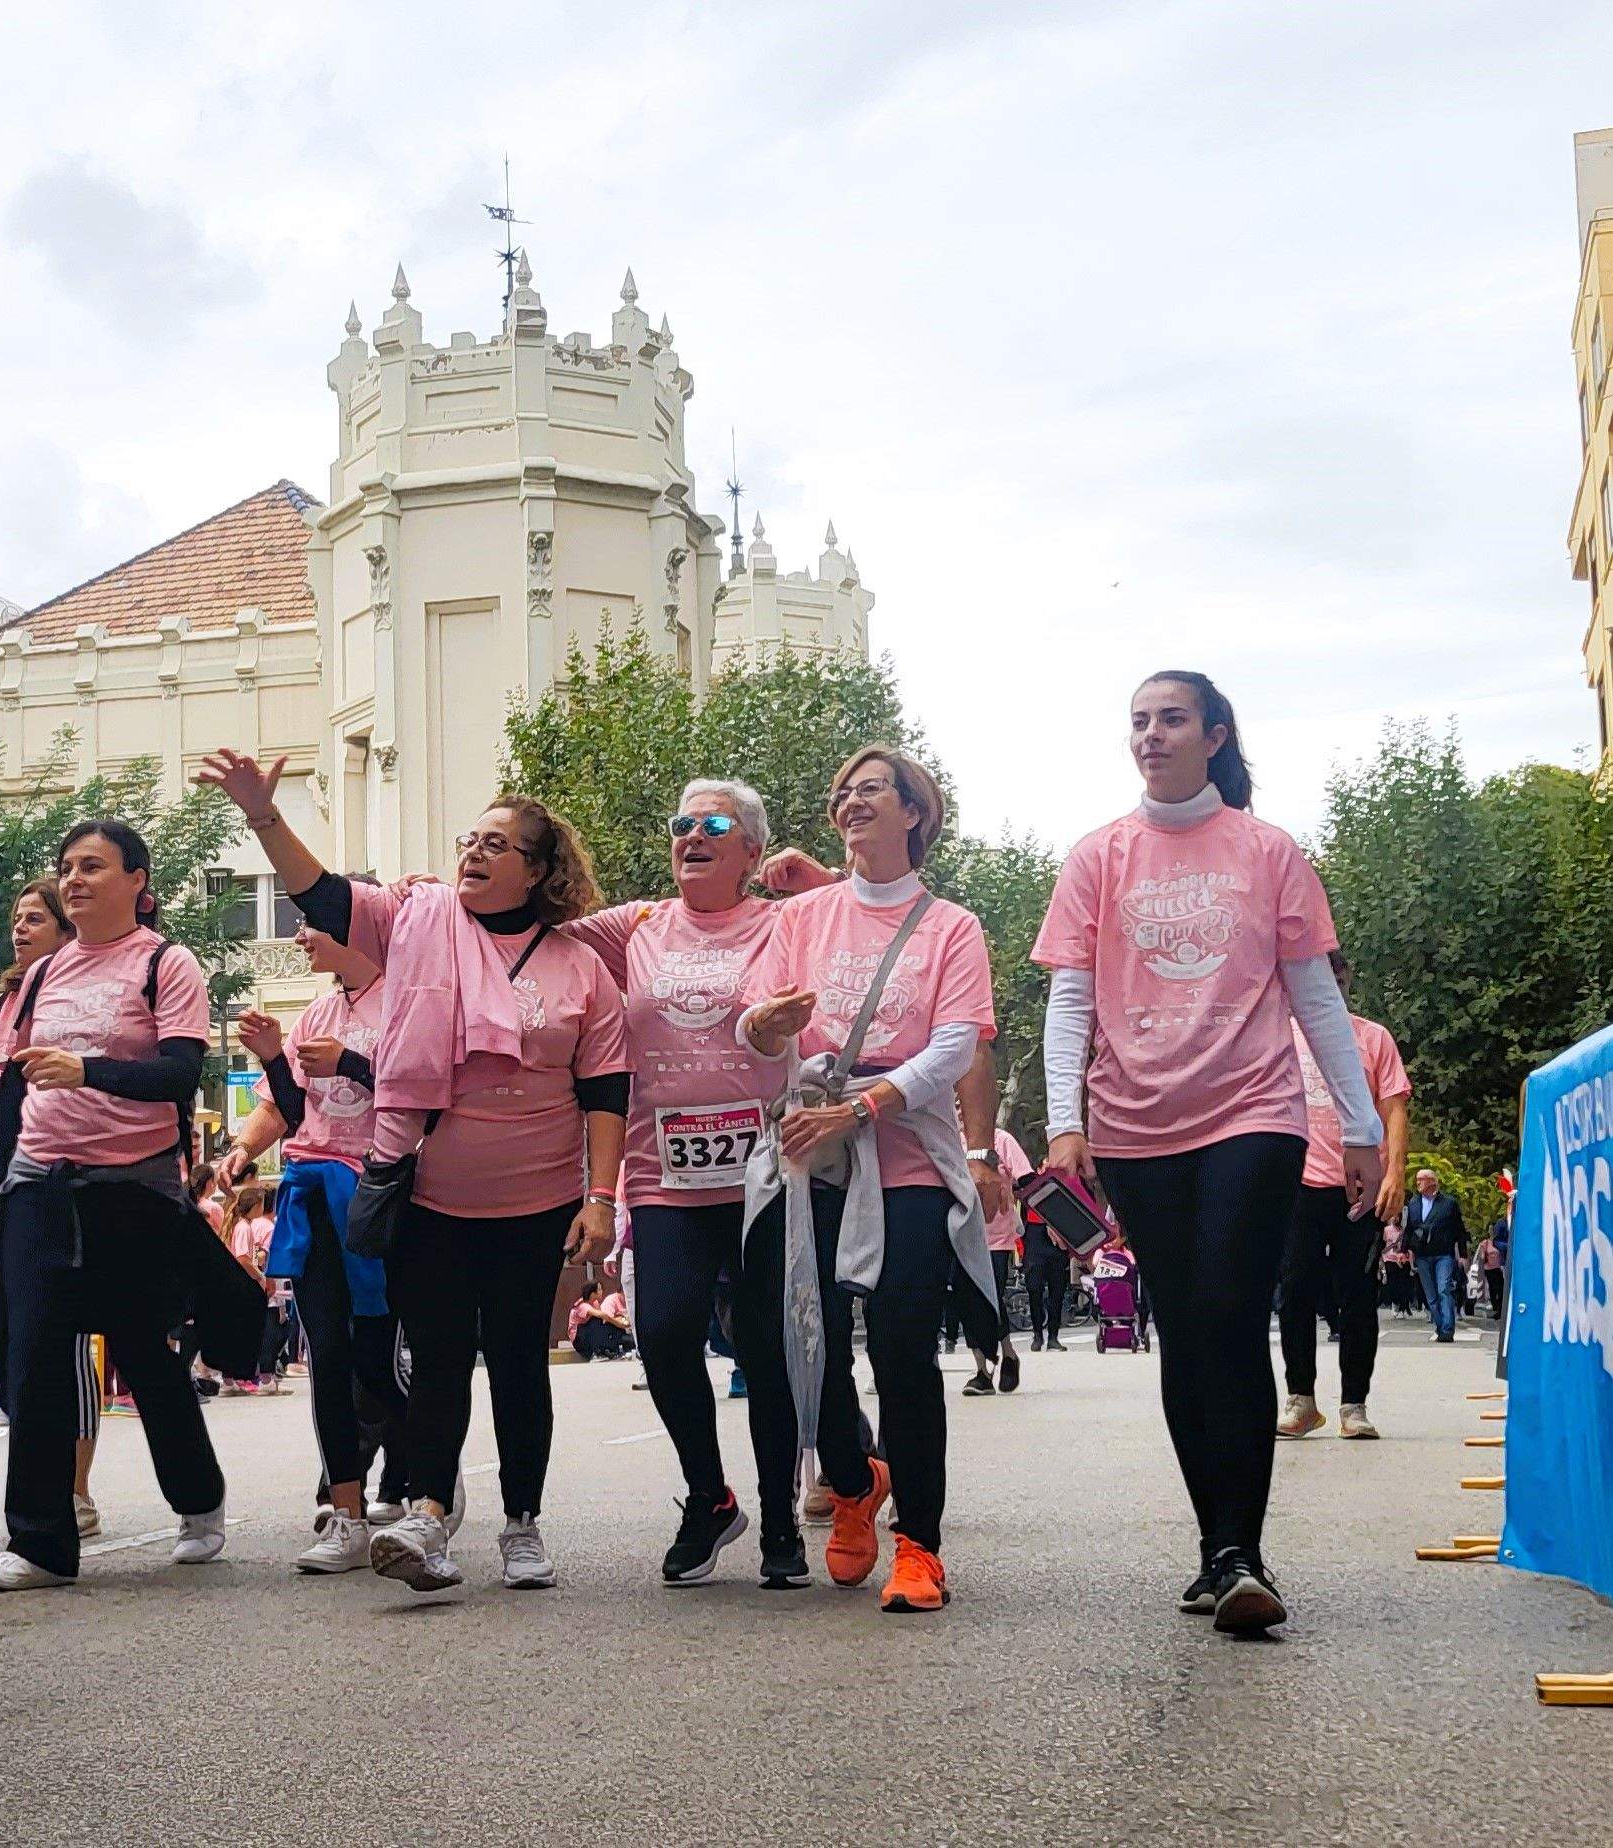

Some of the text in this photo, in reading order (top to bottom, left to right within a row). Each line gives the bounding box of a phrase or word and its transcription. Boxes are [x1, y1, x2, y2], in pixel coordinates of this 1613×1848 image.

[668, 1122, 704, 1133] CONTRA
[705, 1122, 717, 1131] EL
[668, 1131, 758, 1168] 3327
